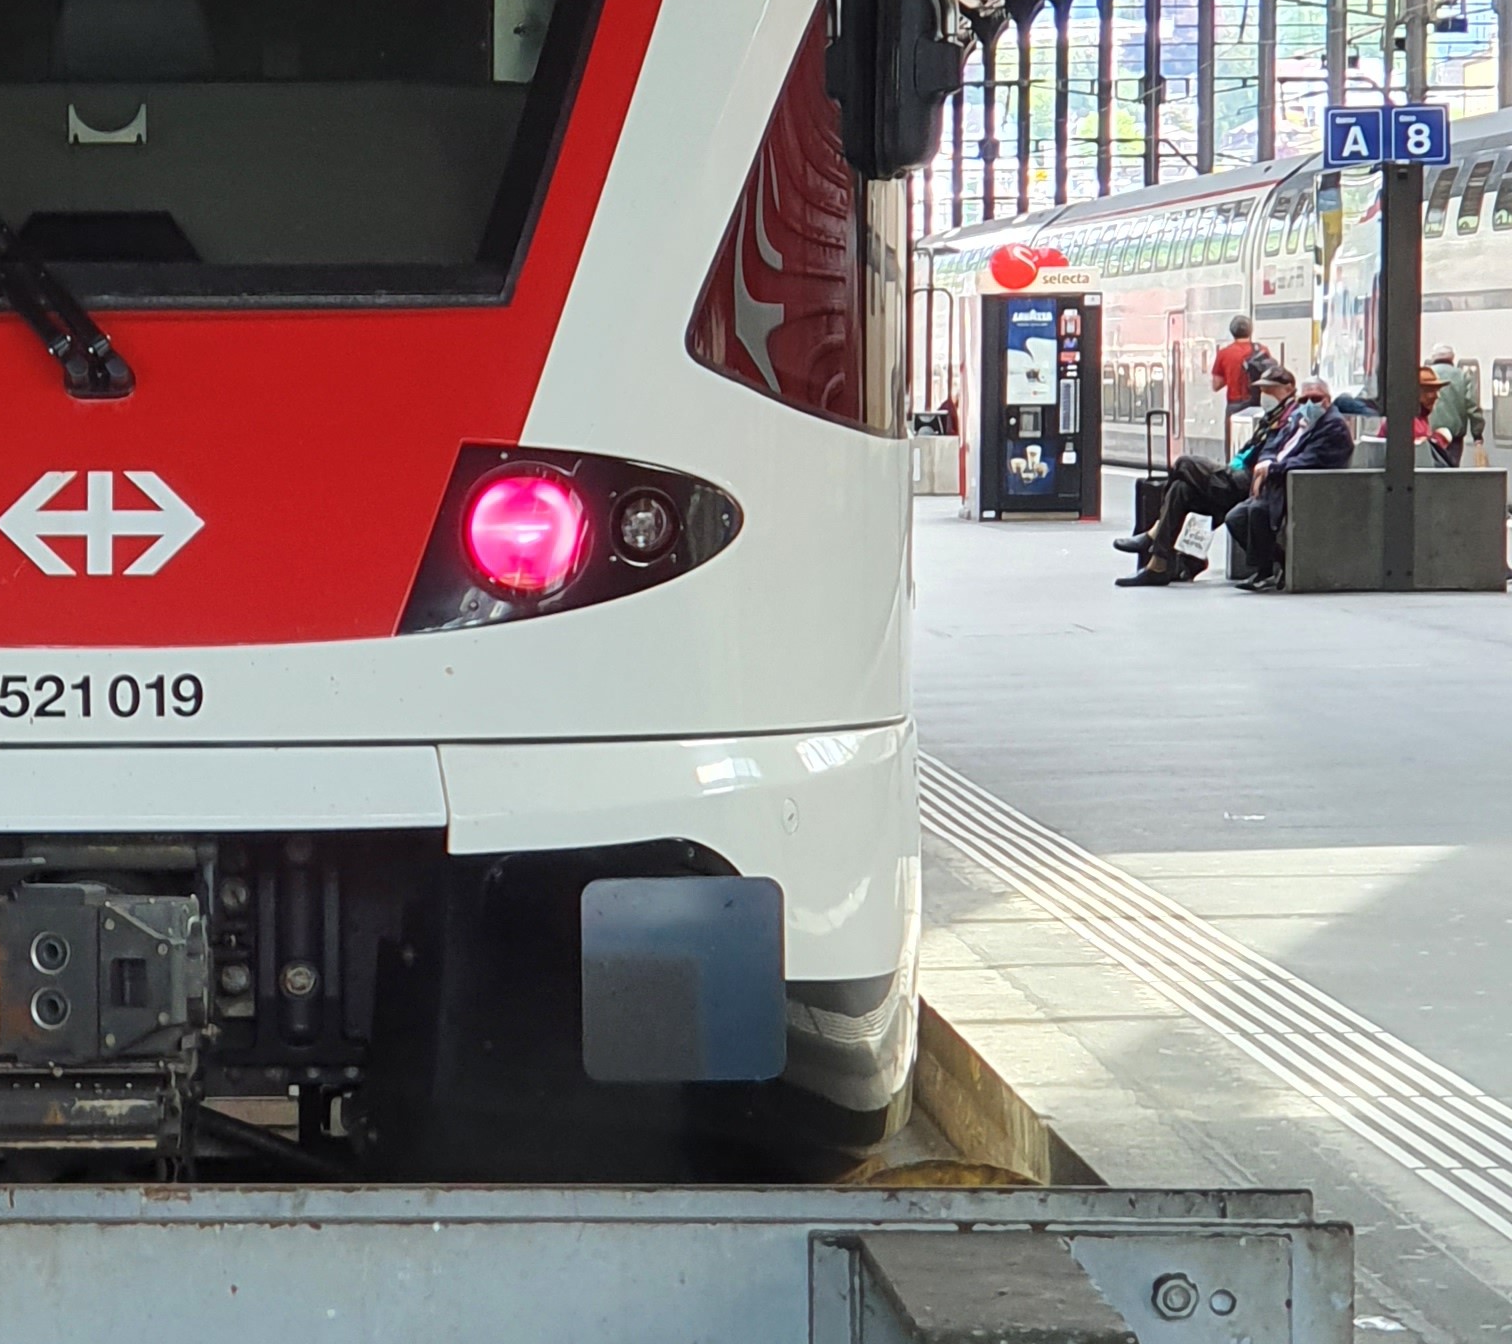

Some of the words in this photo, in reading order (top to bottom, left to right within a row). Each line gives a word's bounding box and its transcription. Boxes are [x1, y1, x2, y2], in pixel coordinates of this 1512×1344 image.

[1342, 125, 1369, 157] A
[1407, 122, 1431, 155] 8
[1042, 273, 1090, 284] selecta
